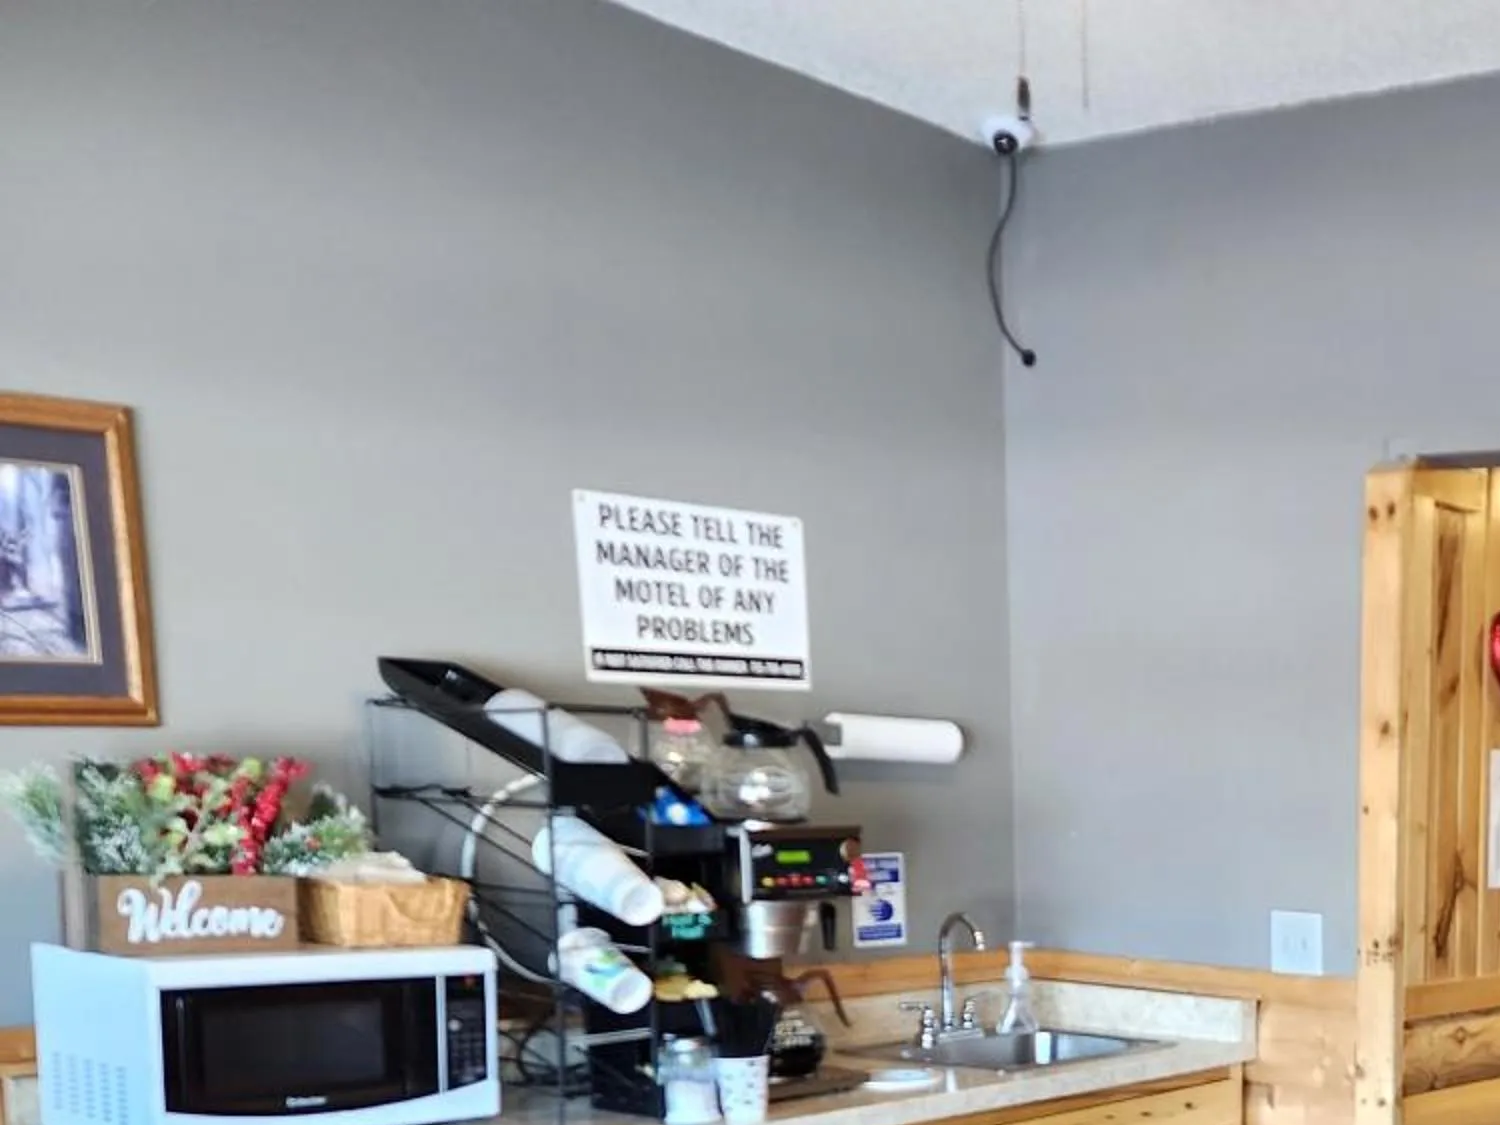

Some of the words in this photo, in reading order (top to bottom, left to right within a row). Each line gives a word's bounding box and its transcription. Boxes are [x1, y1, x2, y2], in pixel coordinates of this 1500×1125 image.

[598, 503, 681, 537] PLEASE
[690, 514, 737, 544] TELL
[746, 521, 784, 549] THE
[596, 540, 710, 576] MANAGER
[718, 553, 744, 577] OF
[751, 557, 789, 583] THE
[615, 577, 690, 609] MOTEL
[698, 585, 725, 609] OF
[733, 590, 775, 615] ANY
[636, 615, 755, 646] PROBLEMS
[117, 880, 285, 943] Welcome
